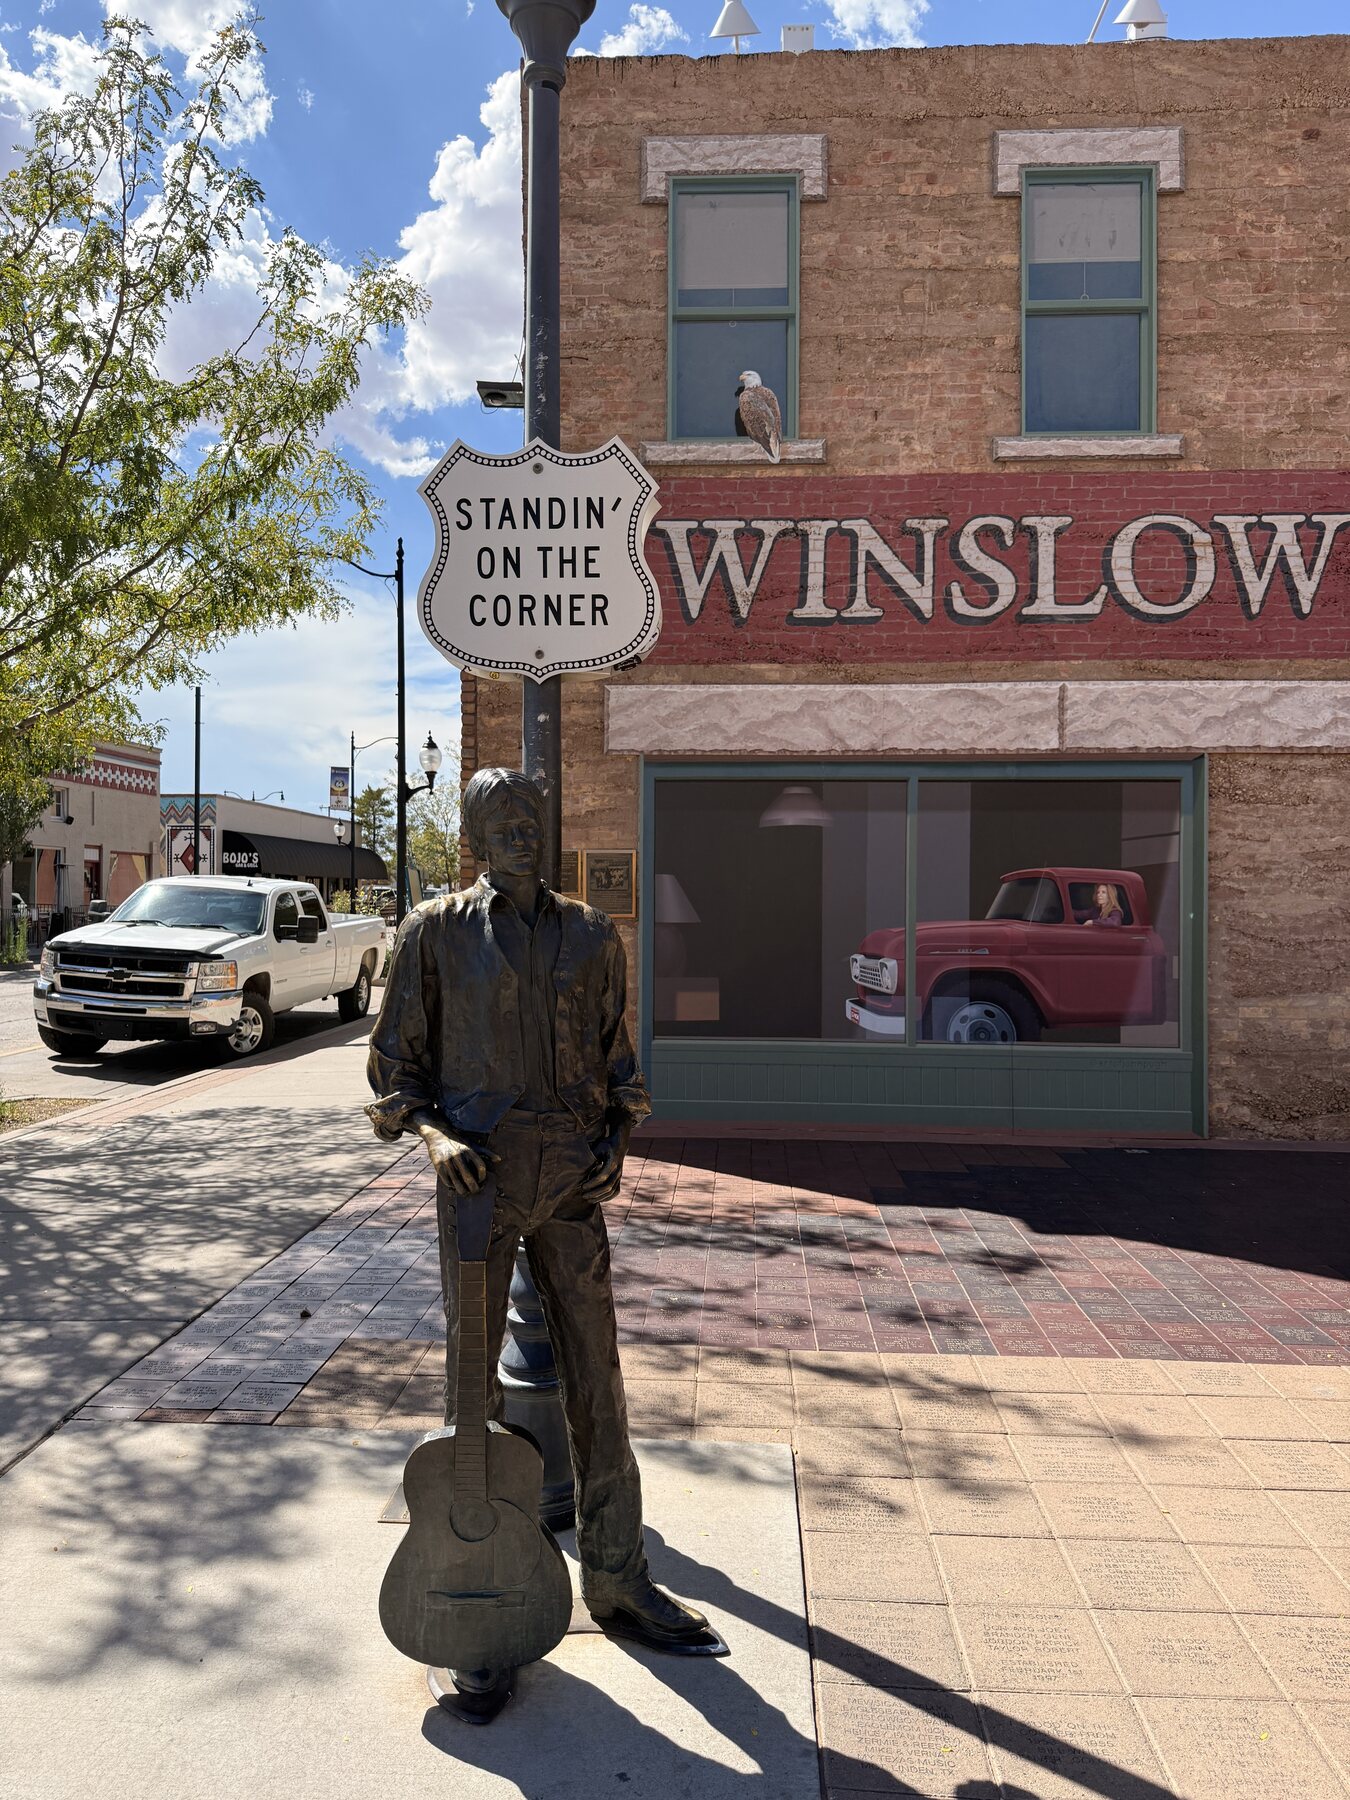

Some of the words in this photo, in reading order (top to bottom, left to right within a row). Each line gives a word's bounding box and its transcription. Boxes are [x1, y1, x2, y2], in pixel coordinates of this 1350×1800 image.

[456, 496, 622, 531] STANDIN'
[477, 546, 521, 580] ON
[537, 546, 601, 579] THE
[650, 514, 1350, 625] WINSLOW
[469, 594, 609, 627] CORNER
[222, 852, 259, 864] BOJO'S
[1013, 1625, 1035, 1633] AND
[982, 1631, 1039, 1640] BRANDON
[988, 1645, 1029, 1653] TAYLOR
[1034, 1646, 1080, 1654] ROBERT
[1000, 1659, 1080, 1668] ESTABLISHED
[857, 1721, 921, 1733] EAGLEMOM
[844, 1728, 889, 1739] HENLEY
[864, 1745, 893, 1755] MIKE
[879, 1755, 915, 1765] TEXAS
[917, 1758, 956, 1769] MUSIC
[940, 1768, 955, 1777] TX
